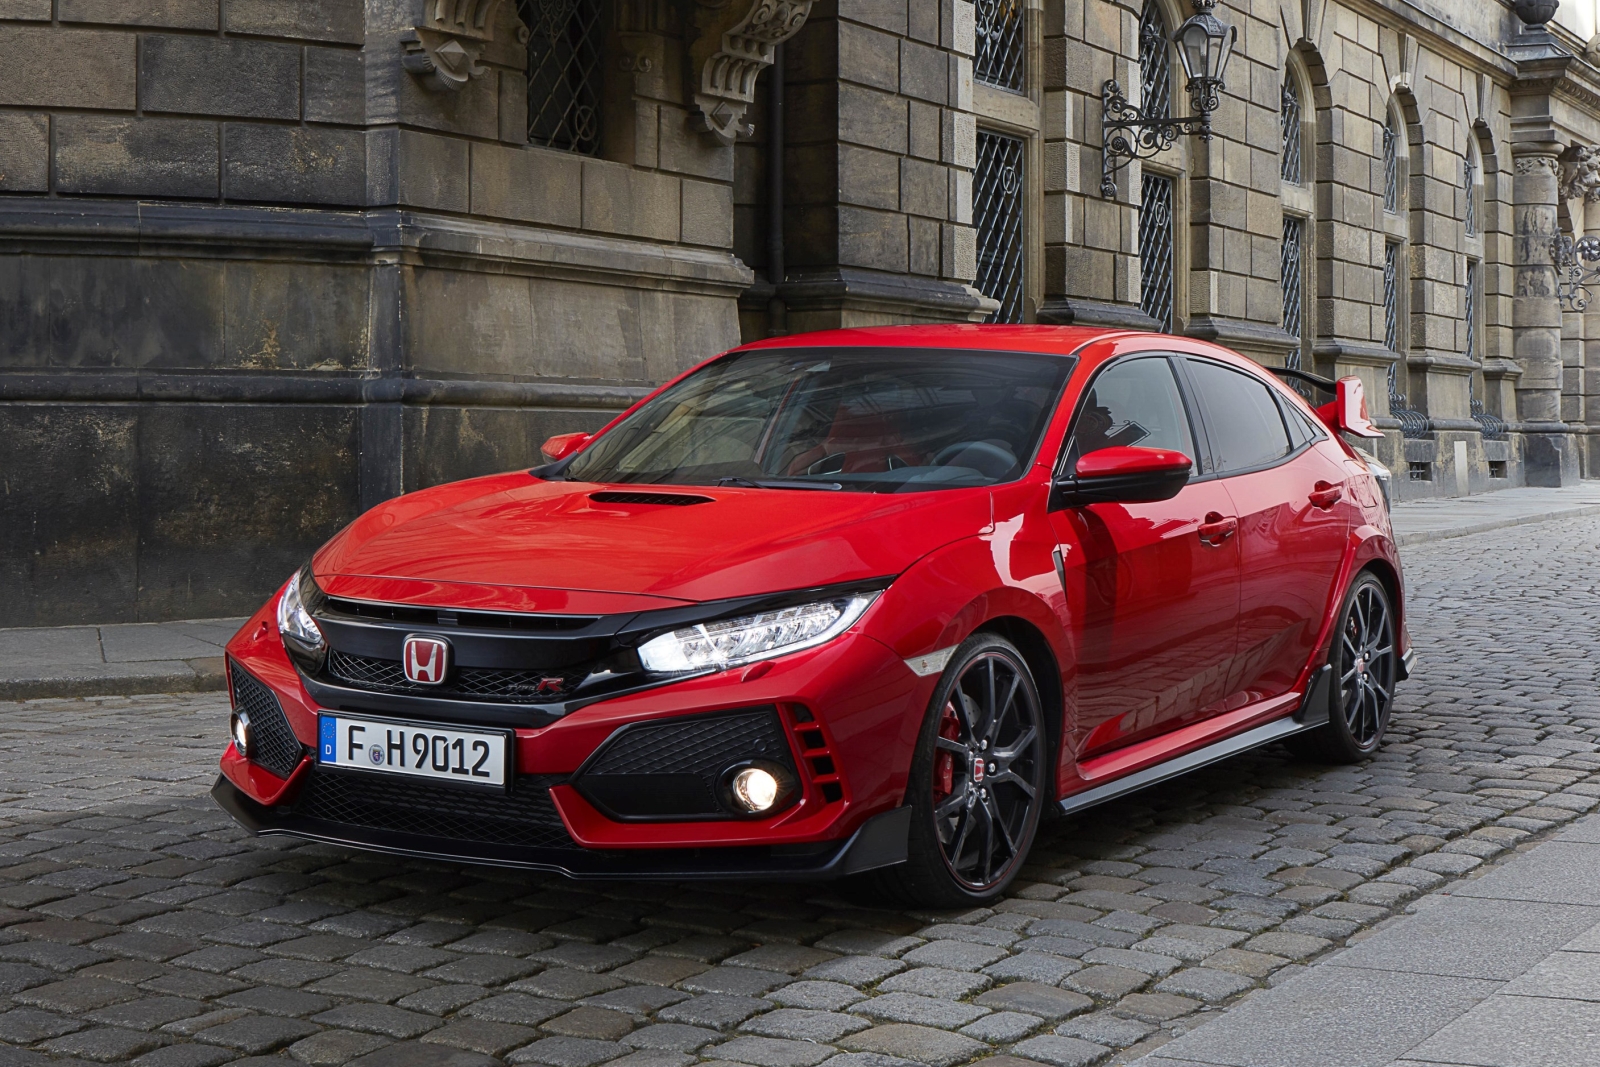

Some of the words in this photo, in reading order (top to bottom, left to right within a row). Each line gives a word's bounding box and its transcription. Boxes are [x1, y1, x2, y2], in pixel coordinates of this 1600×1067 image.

[536, 677, 565, 692] R
[325, 744, 332, 755] D
[348, 725, 365, 760] F
